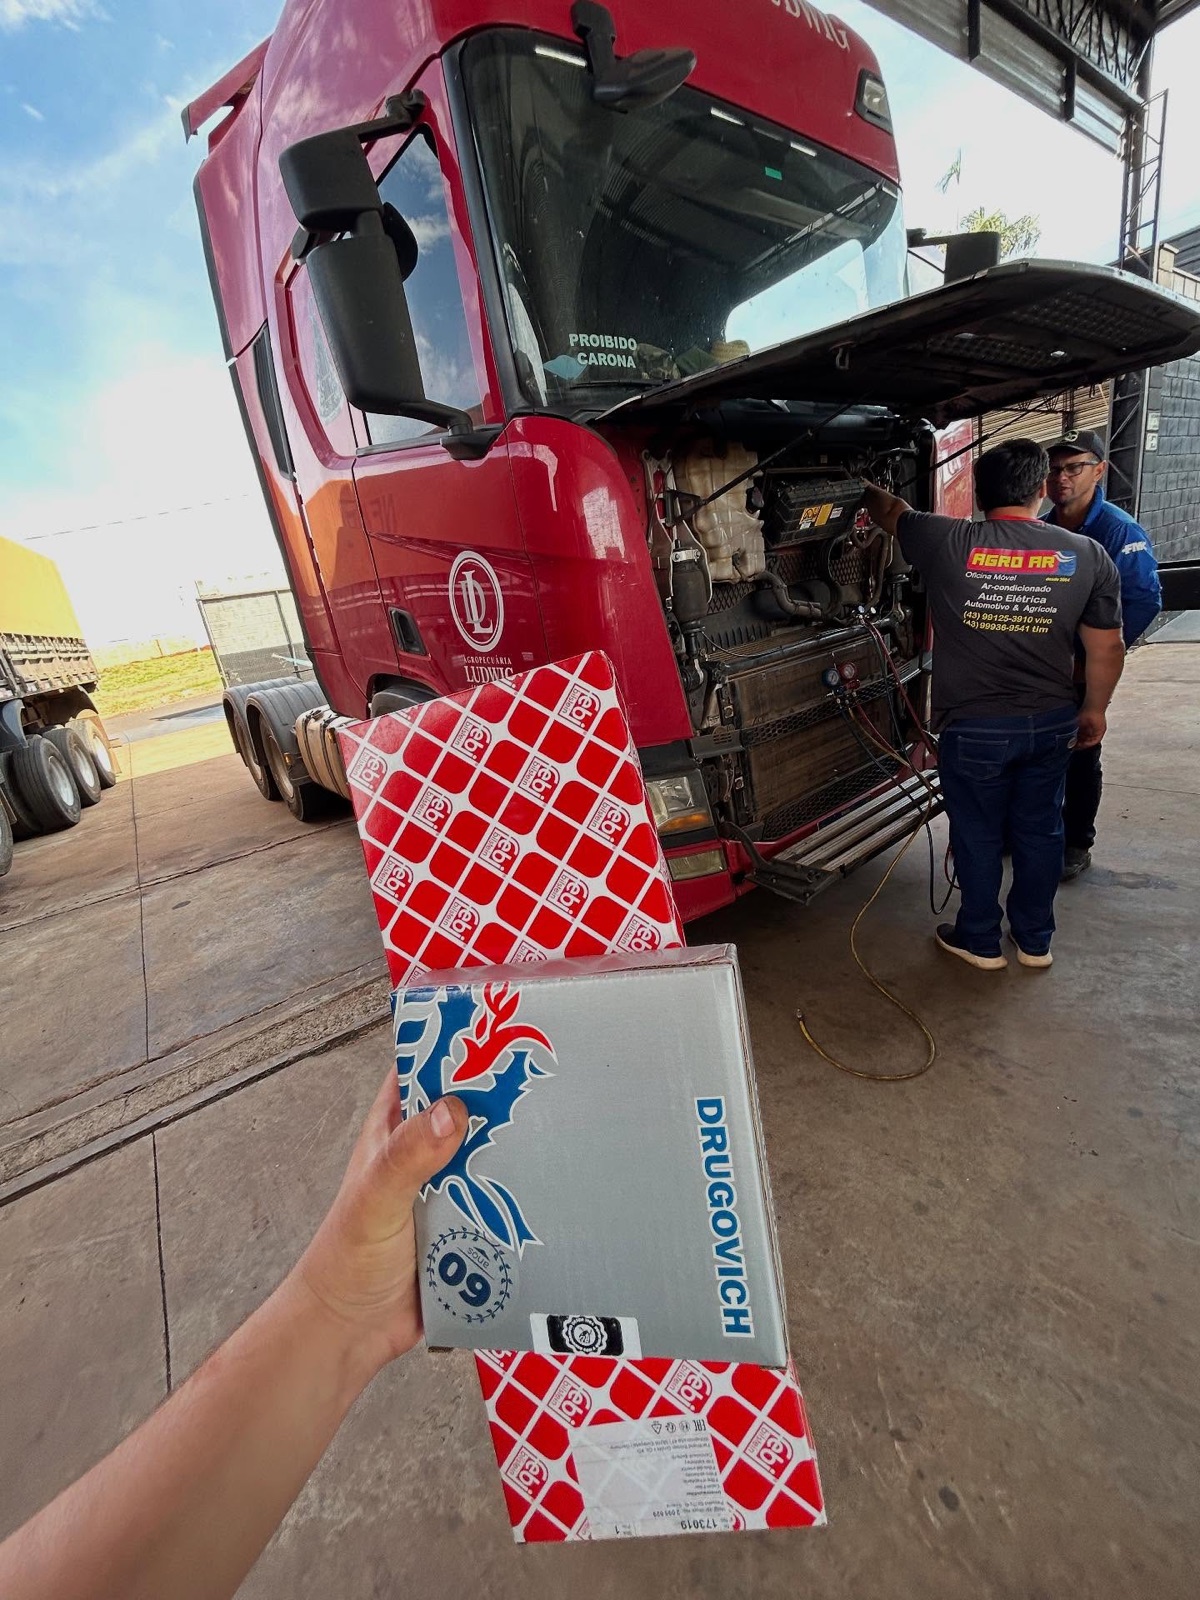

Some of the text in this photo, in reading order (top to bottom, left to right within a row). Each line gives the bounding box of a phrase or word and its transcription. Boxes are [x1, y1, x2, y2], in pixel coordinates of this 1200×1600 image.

[568, 333, 638, 351] PROIBIDO
[577, 352, 636, 369] CARONA
[971, 553, 1055, 569] AGRO AR
[965, 571, 1018, 582] Oficina Móvel
[981, 582, 1052, 593] Ar-condicionado
[978, 592, 1047, 604] Auto Elétrica
[964, 599, 1058, 614] Automotivo & Agrícola
[963, 610, 981, 620] (43)
[1035, 617, 1053, 625] vivo
[1032, 625, 1049, 633] tim
[463, 654, 513, 665] AGROPECUÁRIA
[620, 918, 640, 945] bilstein
[629, 923, 661, 952] feb
[694, 1096, 755, 1338] DRUGOVICH
[467, 1247, 490, 1269] anos
[438, 1252, 492, 1307] 60
[680, 1518, 718, 1530] 173019
